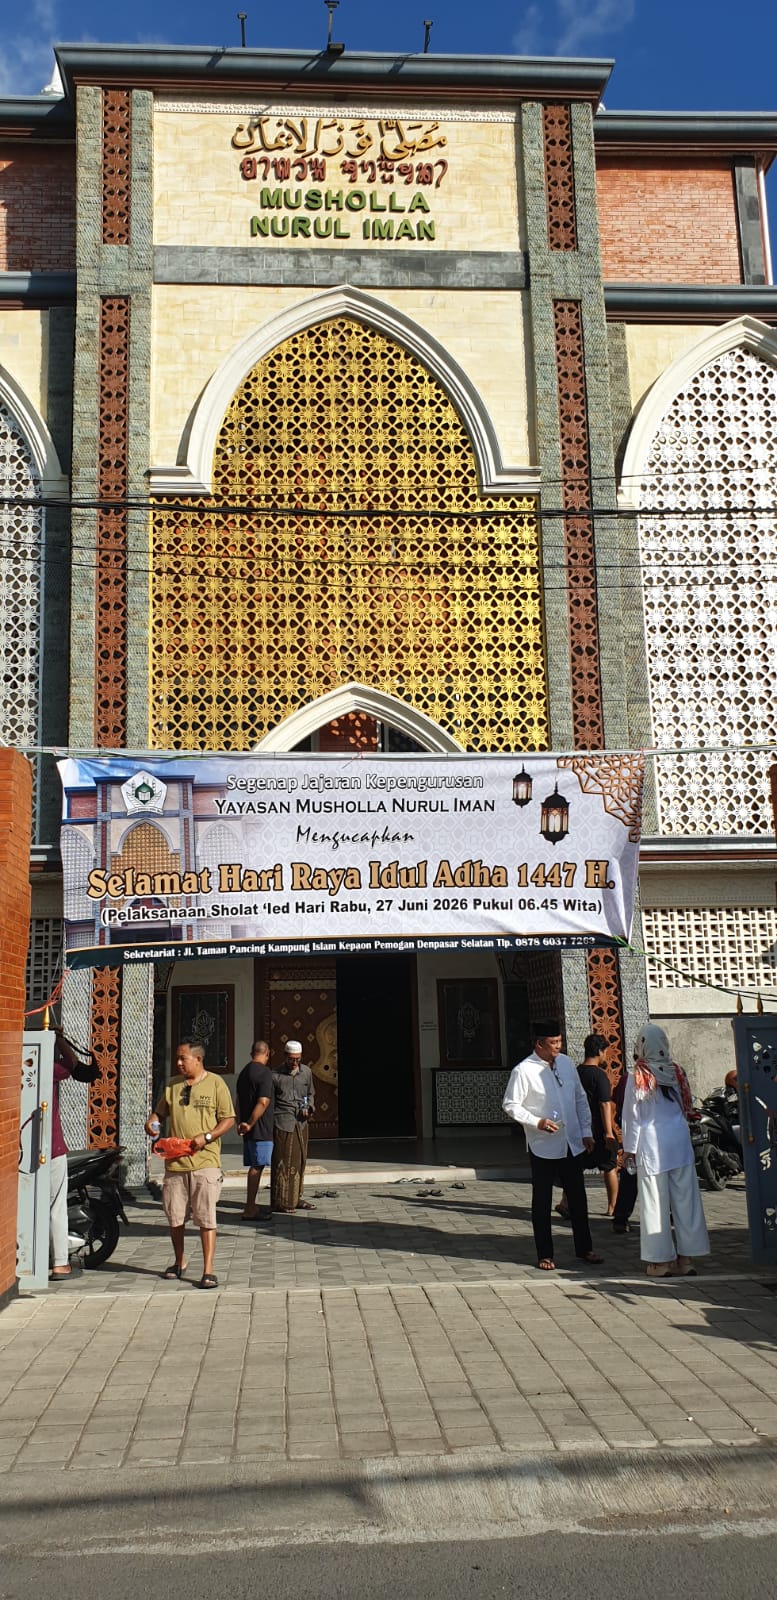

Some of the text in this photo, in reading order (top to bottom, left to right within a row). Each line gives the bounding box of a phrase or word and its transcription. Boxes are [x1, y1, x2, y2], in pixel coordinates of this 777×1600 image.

[260, 187, 430, 213] MUSHOLLA
[250, 216, 435, 241] NURUL IMAN
[227, 774, 484, 793] Segenap Jajaran Kepengurusan
[215, 798, 495, 815] YAYASAN MUSHOLLA NURUL IMAN
[296, 825, 414, 849] Mengucapkan
[87, 860, 616, 899] Selamat Hari Raya Idul Adha 1447 H.
[103, 907, 206, 924] (Pelaksanaan
[211, 903, 258, 917] Sholat
[295, 902, 326, 914] Hari
[331, 900, 371, 915] Rabu,
[376, 900, 393, 912] 27
[398, 899, 428, 912] Juni
[433, 899, 468, 911] 2026
[473, 899, 513, 911] Pukul
[518, 898, 558, 911] 06.45
[563, 899, 602, 915] Wita)
[123, 948, 174, 959] Sekretariat
[197, 945, 227, 956] Taman
[230, 943, 265, 957] Pancing
[268, 942, 310, 955] Kampung
[313, 941, 336, 951] Islam
[340, 940, 372, 952] Kepaon
[375, 940, 414, 951] Pemogan
[417, 939, 458, 951] Denpasar
[461, 938, 494, 948] Selatan
[515, 937, 540, 947] 0878
